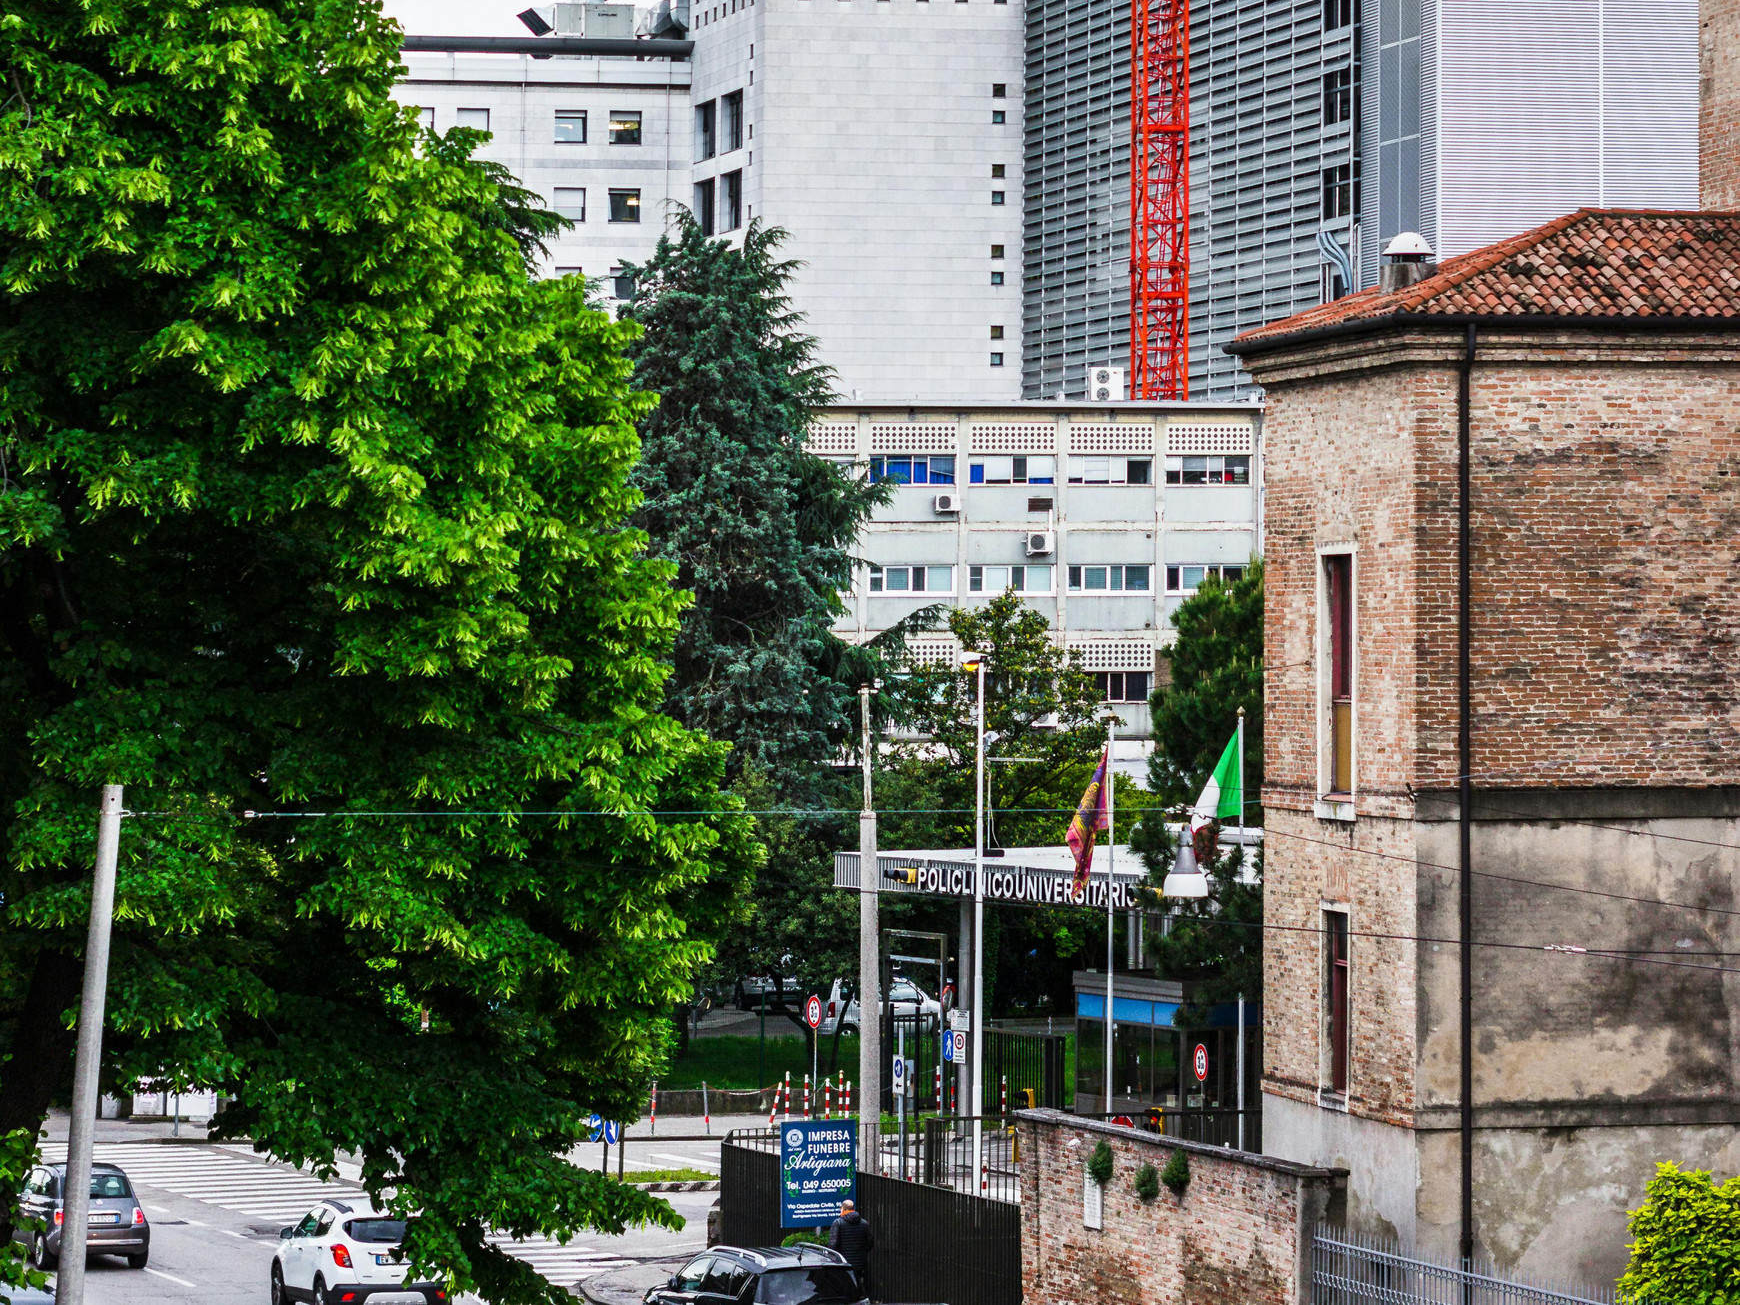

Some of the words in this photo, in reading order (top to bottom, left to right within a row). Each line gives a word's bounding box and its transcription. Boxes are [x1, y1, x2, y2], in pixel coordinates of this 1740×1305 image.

[808, 1130, 850, 1142] IMPRESA
[808, 1142, 850, 1154] FUNEBRE
[784, 1150, 851, 1176] Artigiana
[786, 1181, 801, 1190] Tel.
[803, 1180, 819, 1189] 049
[821, 1179, 851, 1188] 650005
